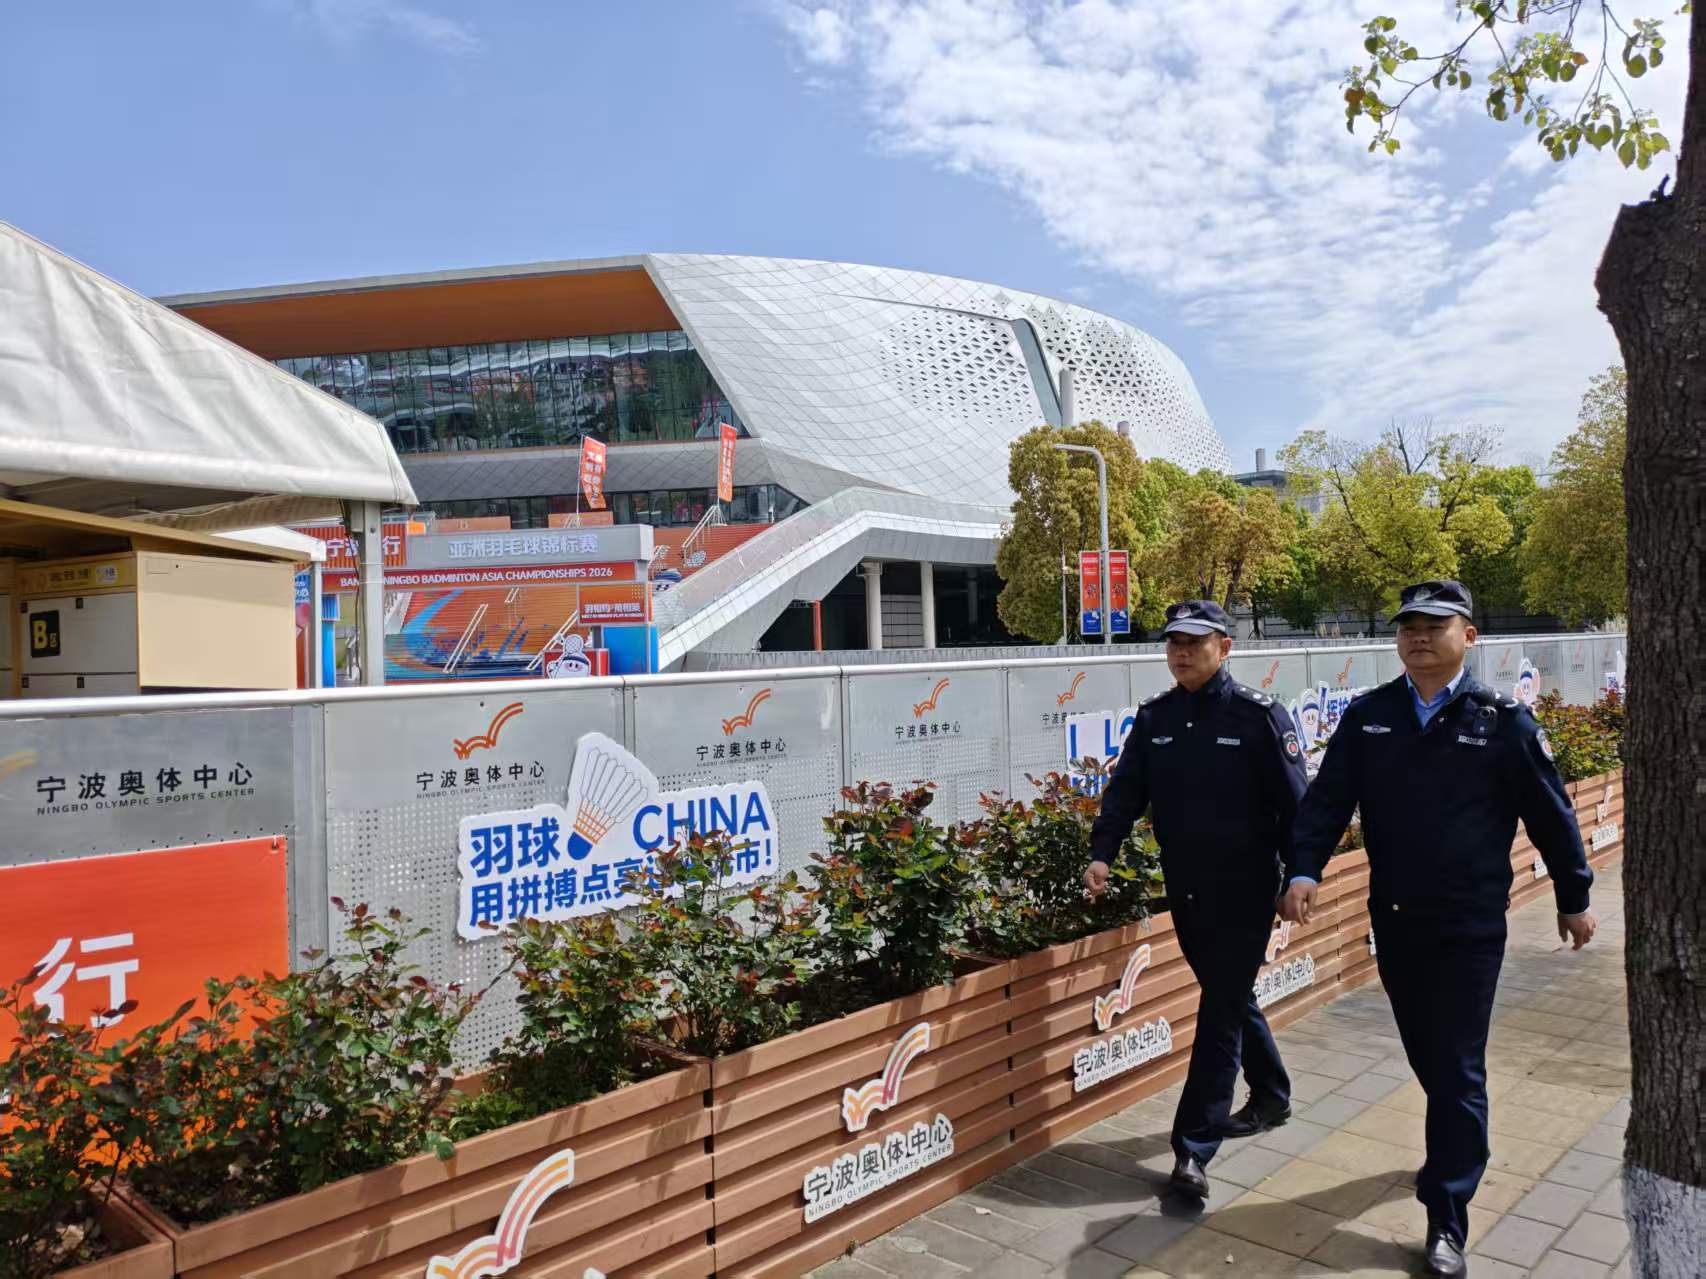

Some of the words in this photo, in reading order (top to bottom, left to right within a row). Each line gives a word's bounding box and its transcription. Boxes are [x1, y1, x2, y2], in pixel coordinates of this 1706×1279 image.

[449, 534, 599, 559] 亚洲羽毛球锦标赛
[384, 576, 420, 586] NINGBO
[421, 572, 480, 584] BADMINTON
[481, 571, 504, 582] ASIA
[505, 567, 586, 581] CHAMPIONSHIPS
[588, 567, 613, 578] 2026
[696, 737, 786, 761] 宁波奥体中心
[895, 720, 961, 740] 宁波奥体中心
[36, 762, 253, 803] 宁波奥体中心
[416, 760, 544, 791] 宁波奥体中心
[37, 803, 89, 816] NINGBO
[96, 797, 149, 811] OLYMPIC
[156, 792, 205, 804] SPORTS
[210, 788, 255, 799] CENTER
[633, 791, 770, 851] CHINA
[470, 817, 561, 878] 羽球
[33, 932, 139, 1038] 行
[1076, 1021, 1169, 1076] 宁波奥体中心
[808, 1118, 950, 1203] 宁波奥体中心
[808, 1194, 843, 1217] NINGBO
[847, 1177, 883, 1199] OLYMPIC
[887, 1160, 919, 1179] SPORTS
[922, 1143, 951, 1163] CENTER
